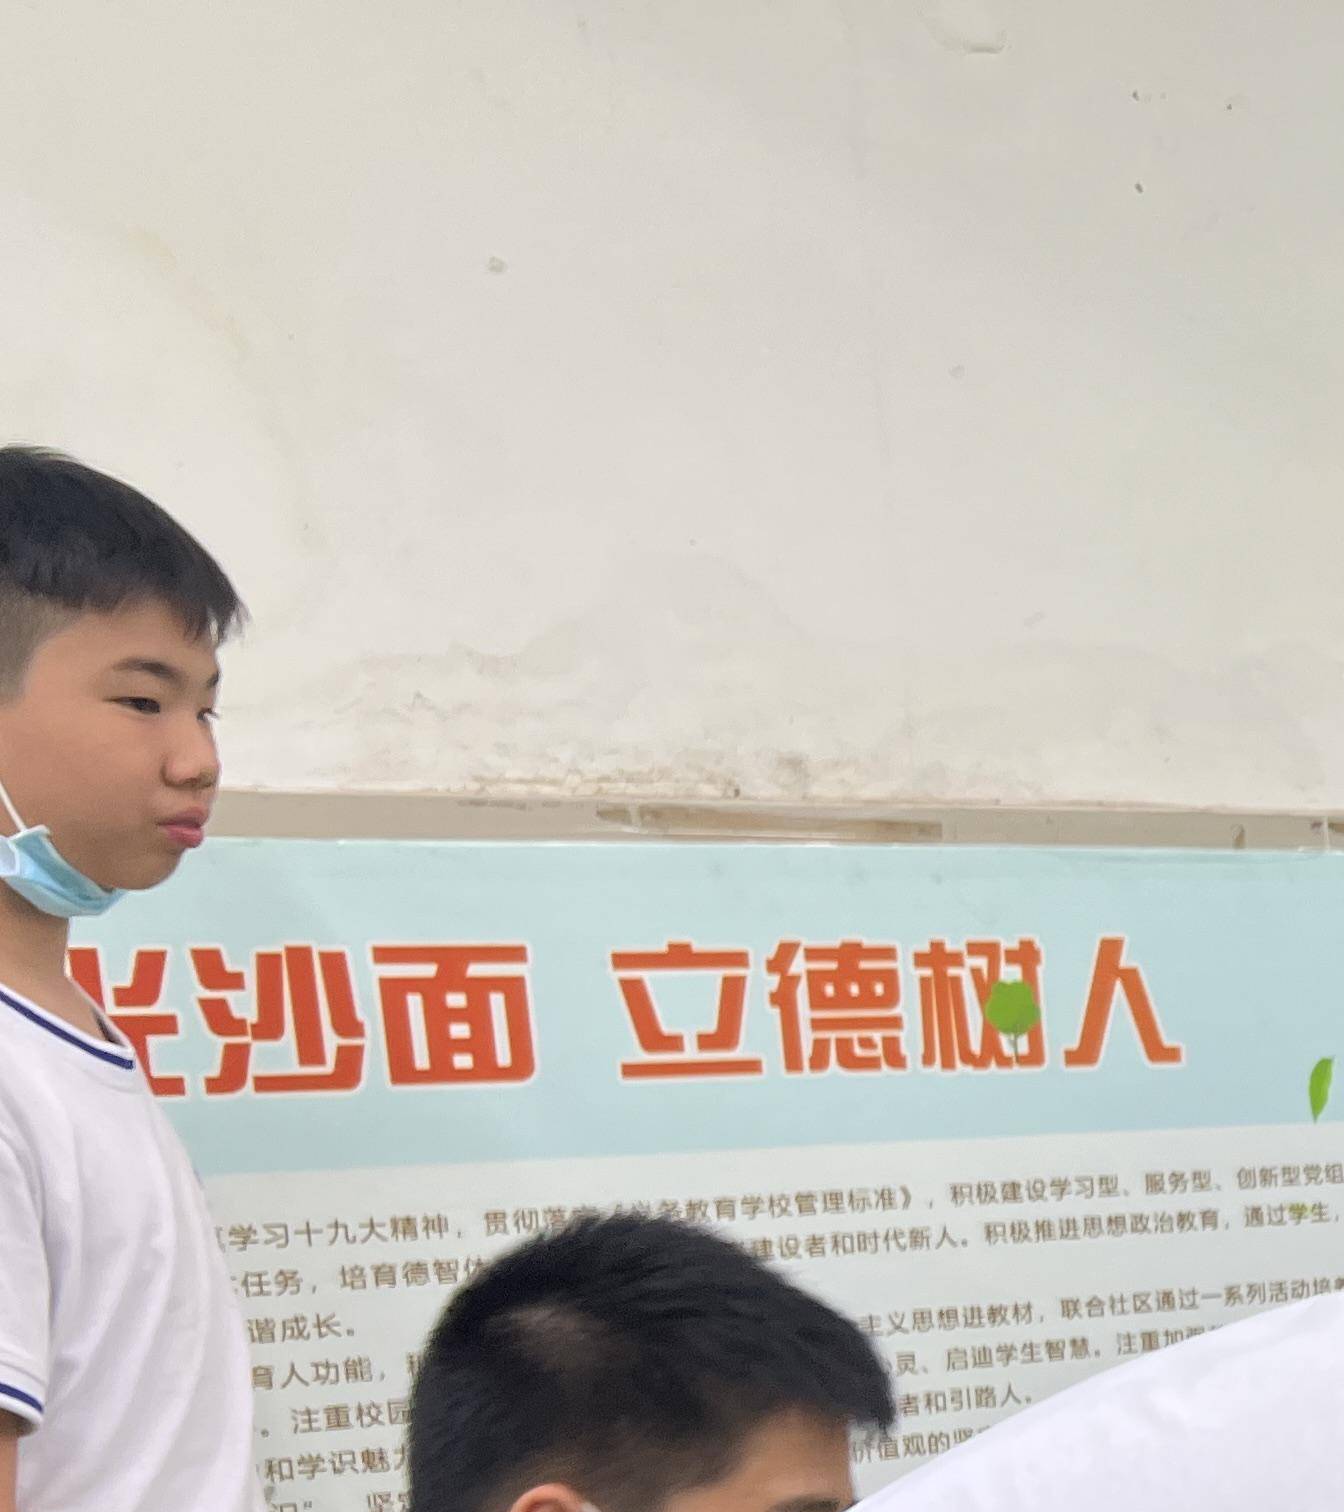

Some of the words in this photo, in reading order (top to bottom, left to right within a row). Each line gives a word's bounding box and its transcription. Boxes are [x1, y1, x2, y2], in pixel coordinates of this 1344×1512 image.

[611, 936, 1182, 1081] 立德树人
[229, 1255, 482, 1298] 任务，培育德智
